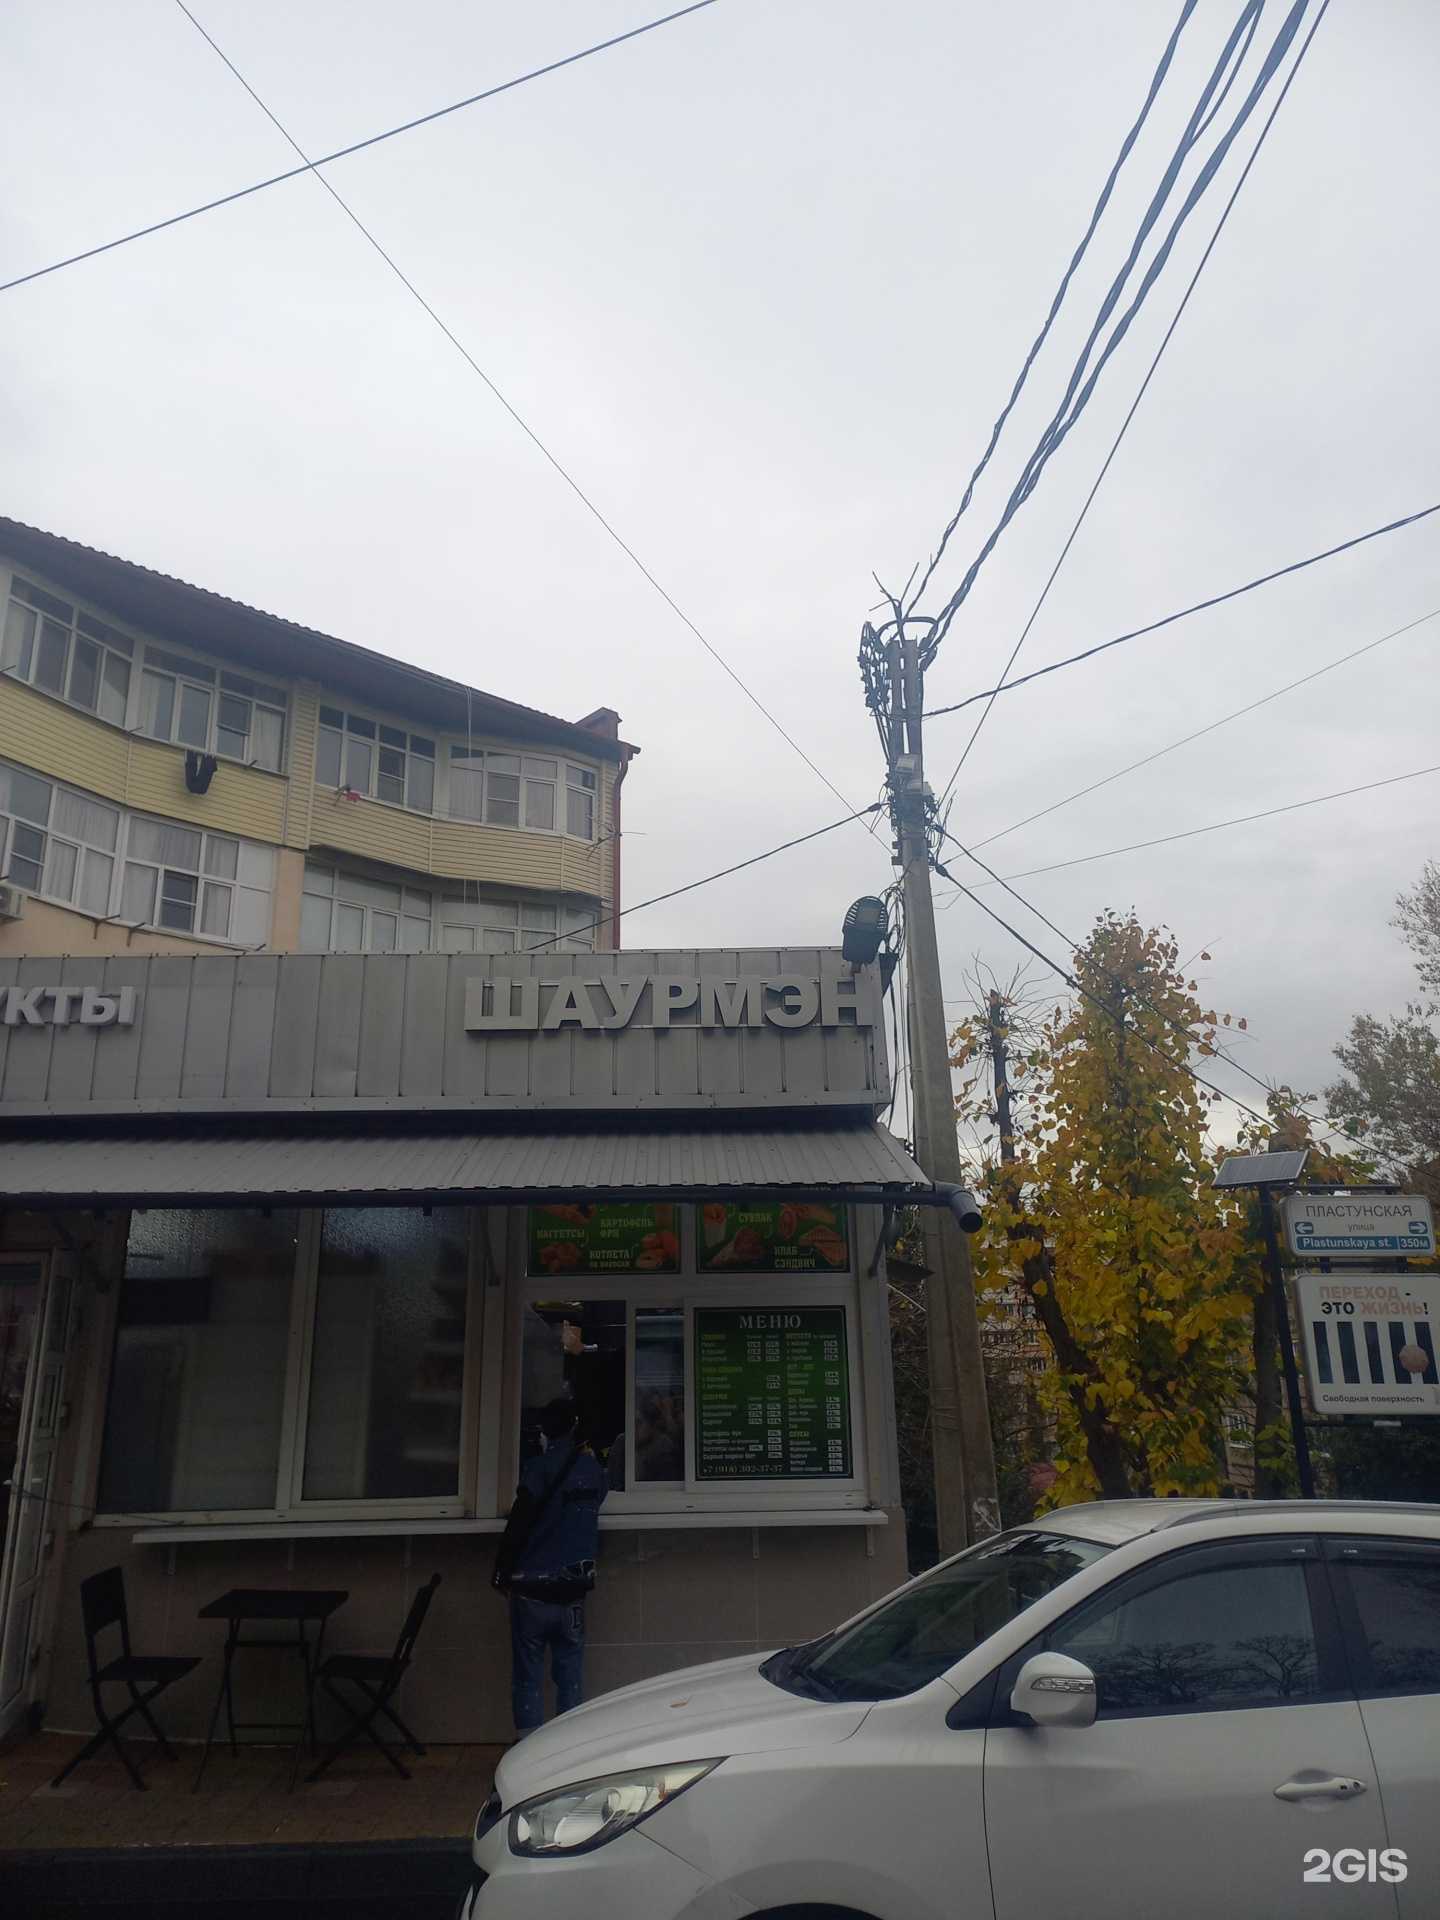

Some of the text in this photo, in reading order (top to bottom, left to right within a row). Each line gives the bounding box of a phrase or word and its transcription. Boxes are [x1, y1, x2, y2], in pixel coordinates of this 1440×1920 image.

[0, 986, 137, 1025] КТЫ
[464, 975, 873, 1031] ШАУРМЭН
[1304, 1204, 1413, 1217] ПЛАСТУНСКАЯ
[1347, 1223, 1375, 1233] улица
[1302, 1237, 1392, 1250] Plastunskaya st.
[1319, 1286, 1400, 1301] ПЕРЕХОД
[1321, 1302, 1429, 1315] ЭТО ЖИЗНЬ!
[738, 1314, 801, 1329] МЕНЮ
